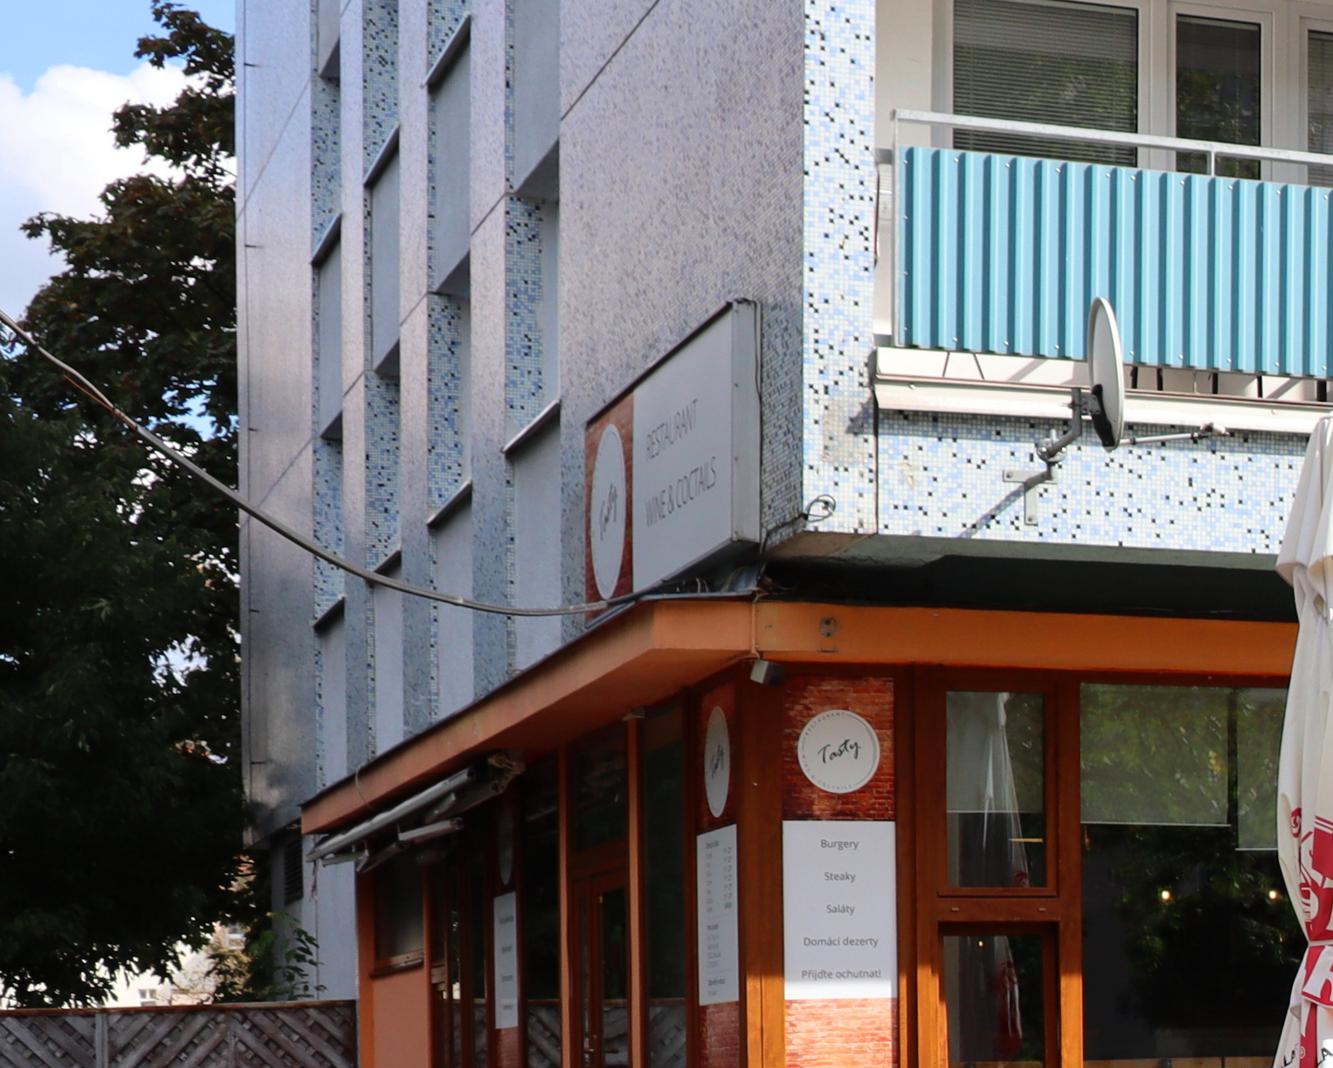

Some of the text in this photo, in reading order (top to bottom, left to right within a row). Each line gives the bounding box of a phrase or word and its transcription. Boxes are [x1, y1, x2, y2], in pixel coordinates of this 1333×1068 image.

[646, 398, 698, 462] RESTAURANT
[645, 489, 666, 528] WINE
[676, 456, 716, 508] COCTAILS
[817, 738, 861, 764] Tasty
[820, 839, 860, 851] Burgery
[824, 871, 856, 883] Steaky
[826, 904, 856, 916] Saláty
[803, 936, 879, 948] Domácí dezerty
[801, 969, 882, 981] Přijďte ochutnat!
